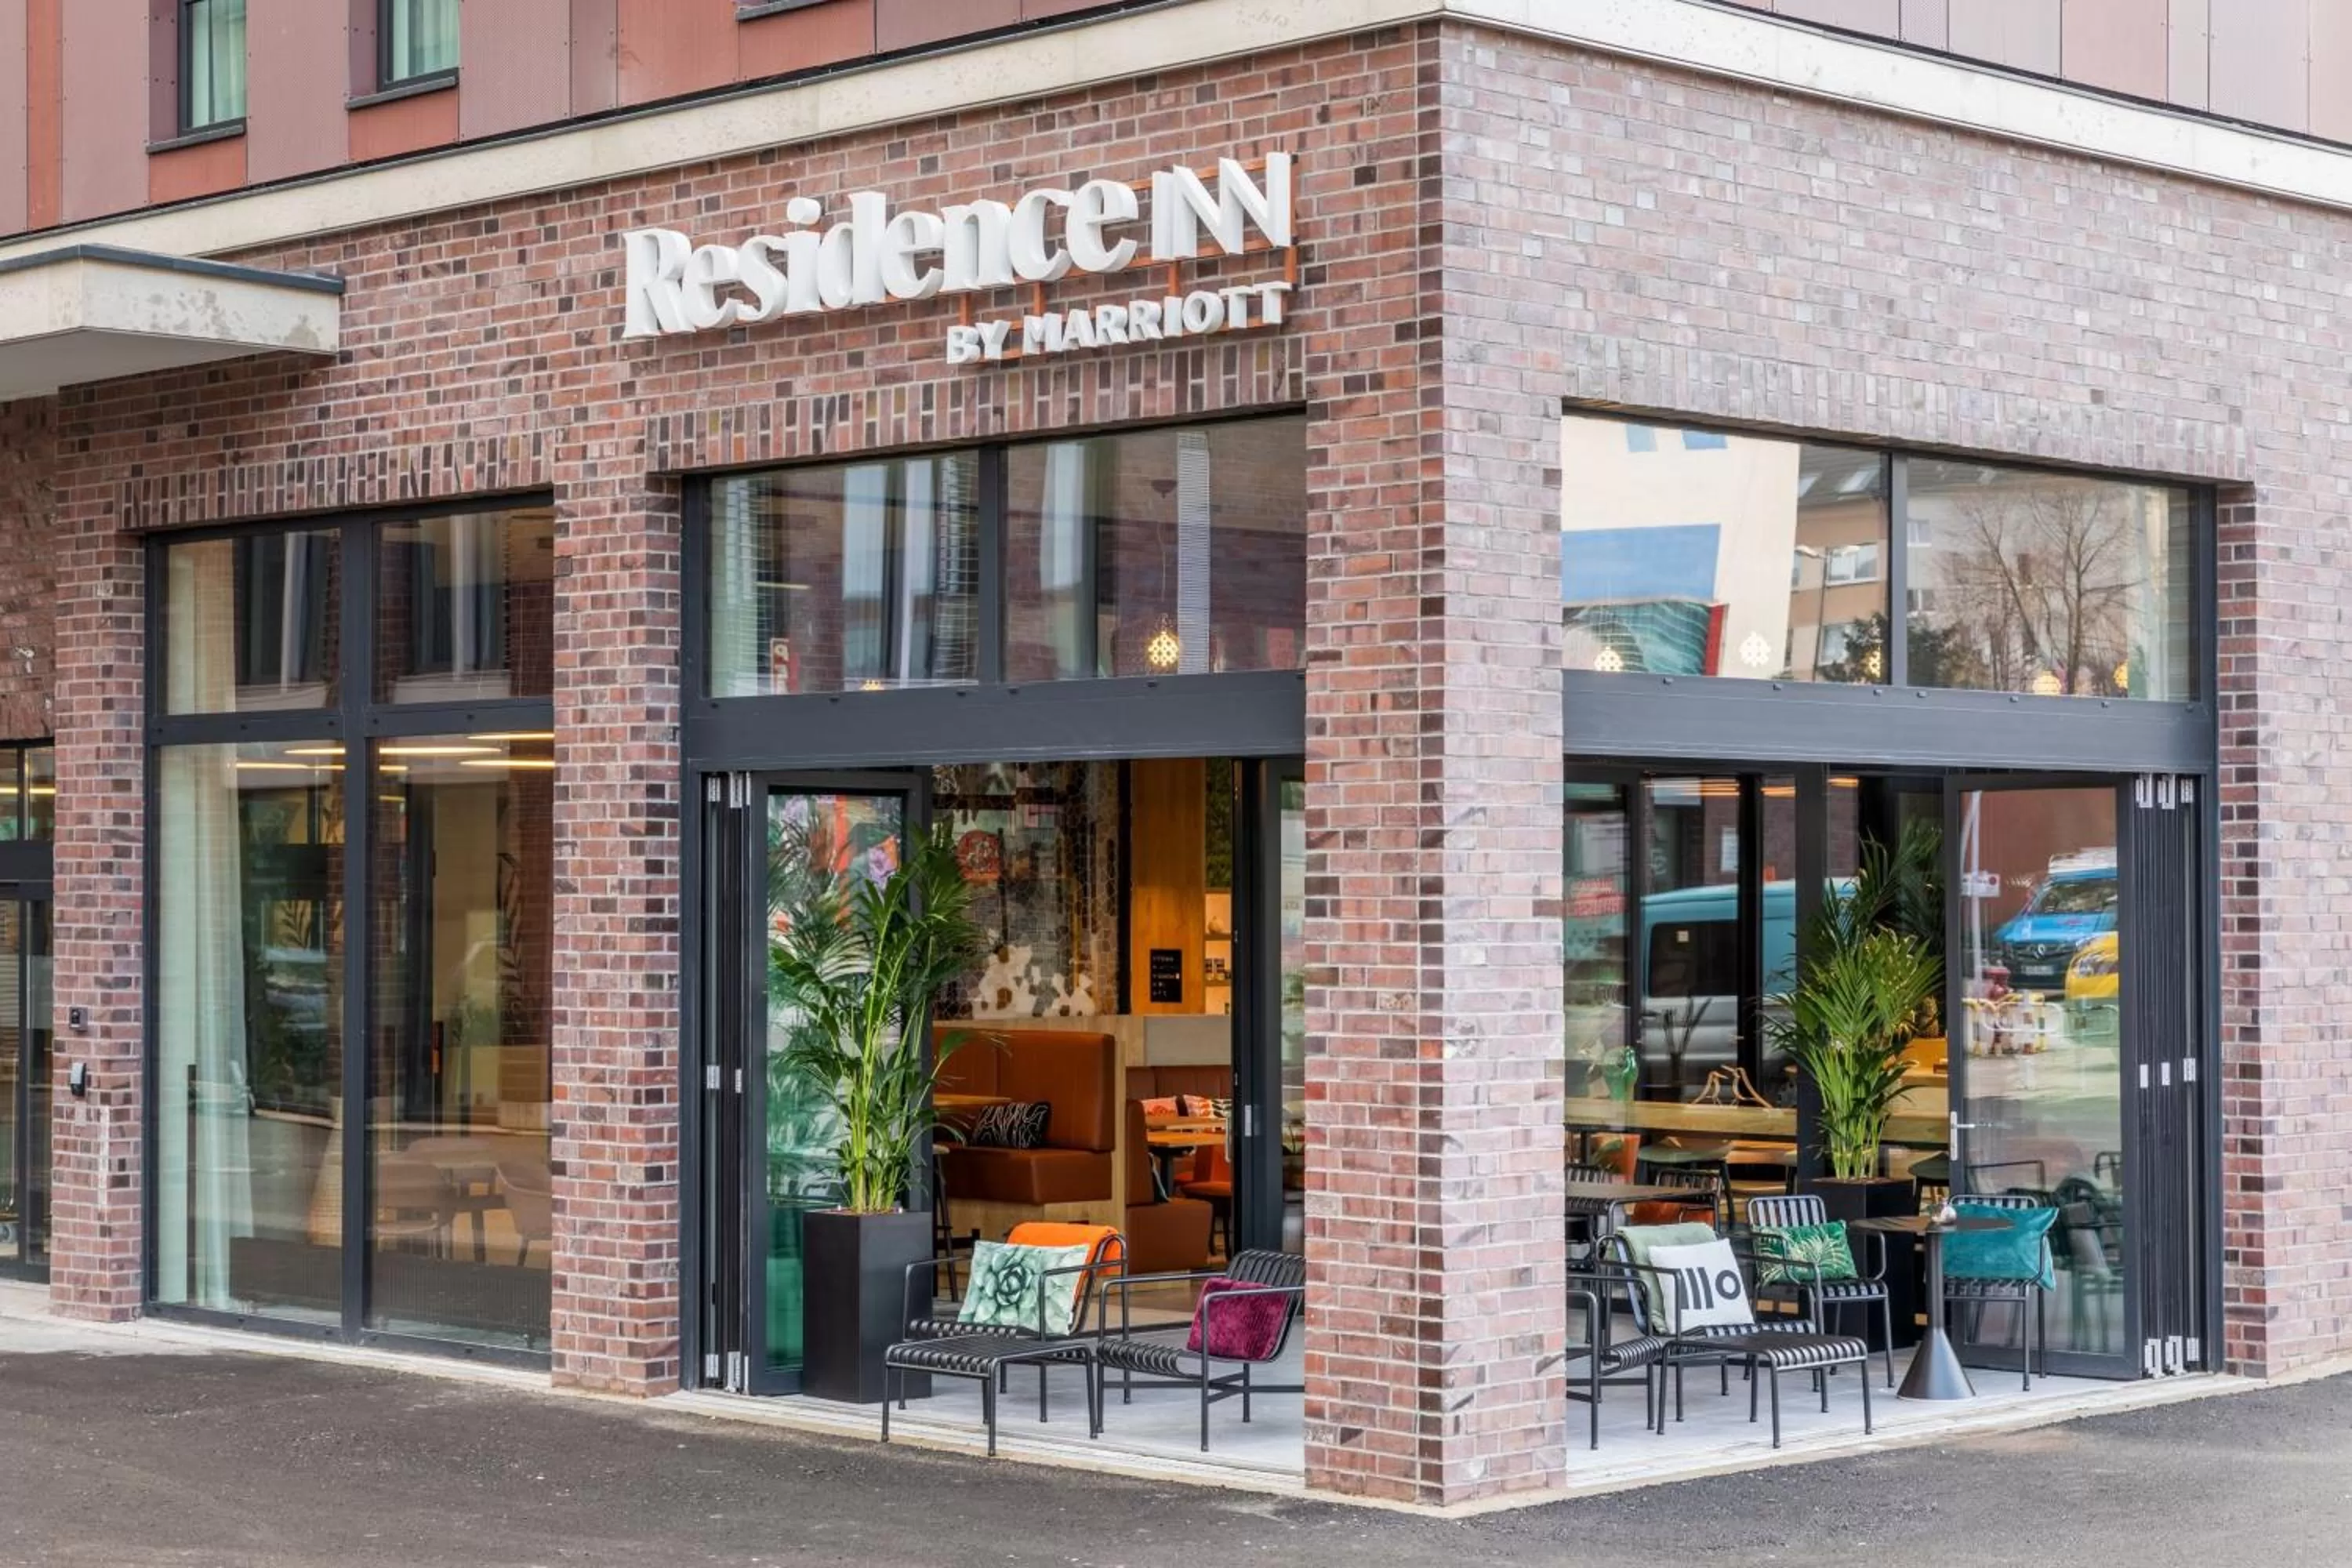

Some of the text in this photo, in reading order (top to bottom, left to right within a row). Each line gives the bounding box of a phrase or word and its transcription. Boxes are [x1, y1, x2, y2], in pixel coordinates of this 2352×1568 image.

[622, 151, 1292, 339] Residence INN
[946, 280, 1293, 364] BY MARRIOTT
